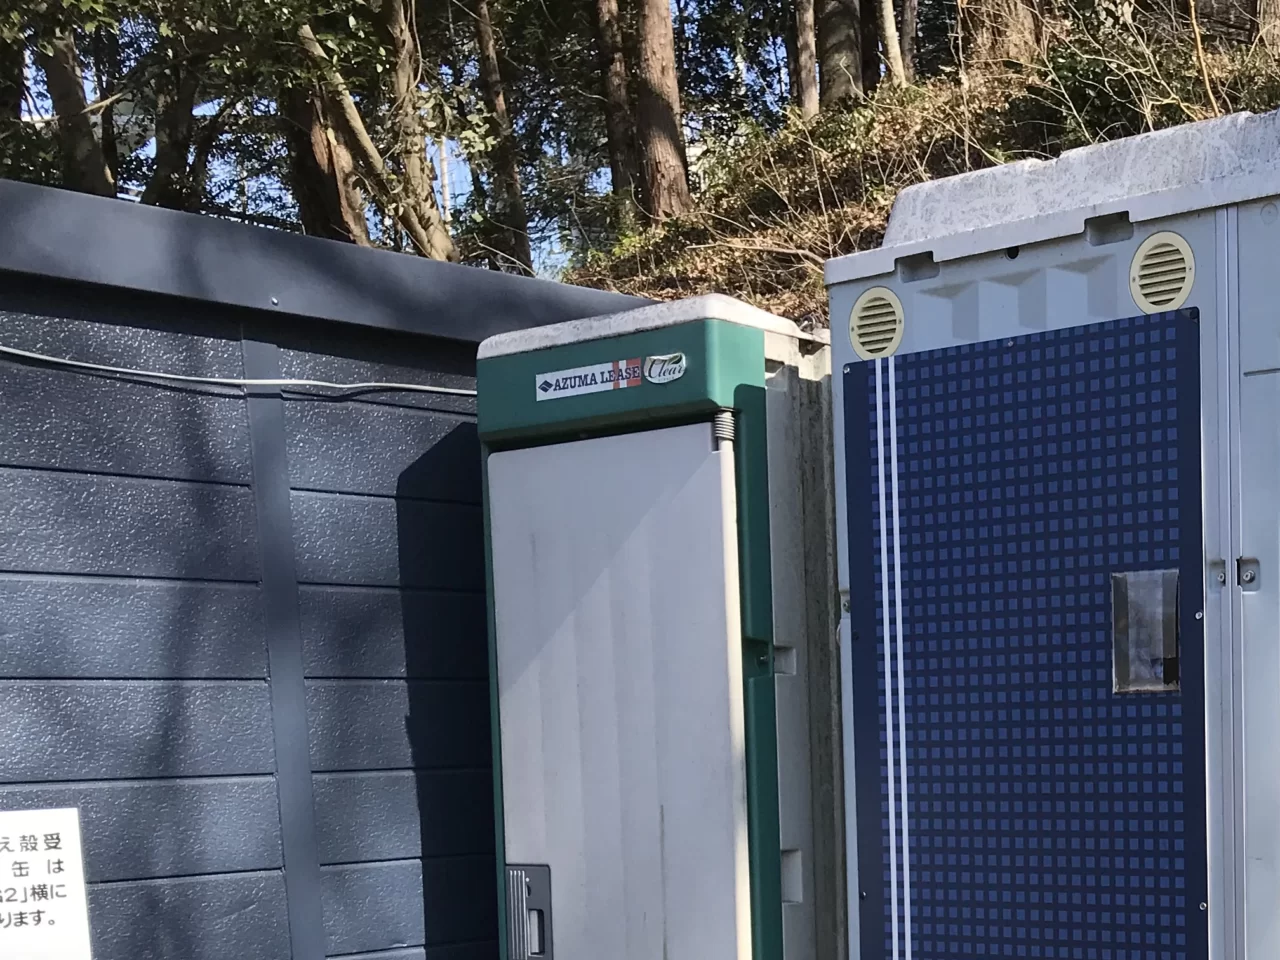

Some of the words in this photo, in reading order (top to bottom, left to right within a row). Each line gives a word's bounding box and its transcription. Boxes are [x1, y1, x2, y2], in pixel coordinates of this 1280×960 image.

[553, 375, 598, 392] AZUMA
[600, 366, 642, 384] LEASE
[648, 358, 685, 379] Clear
[0, 883, 67, 904] 2」横に
